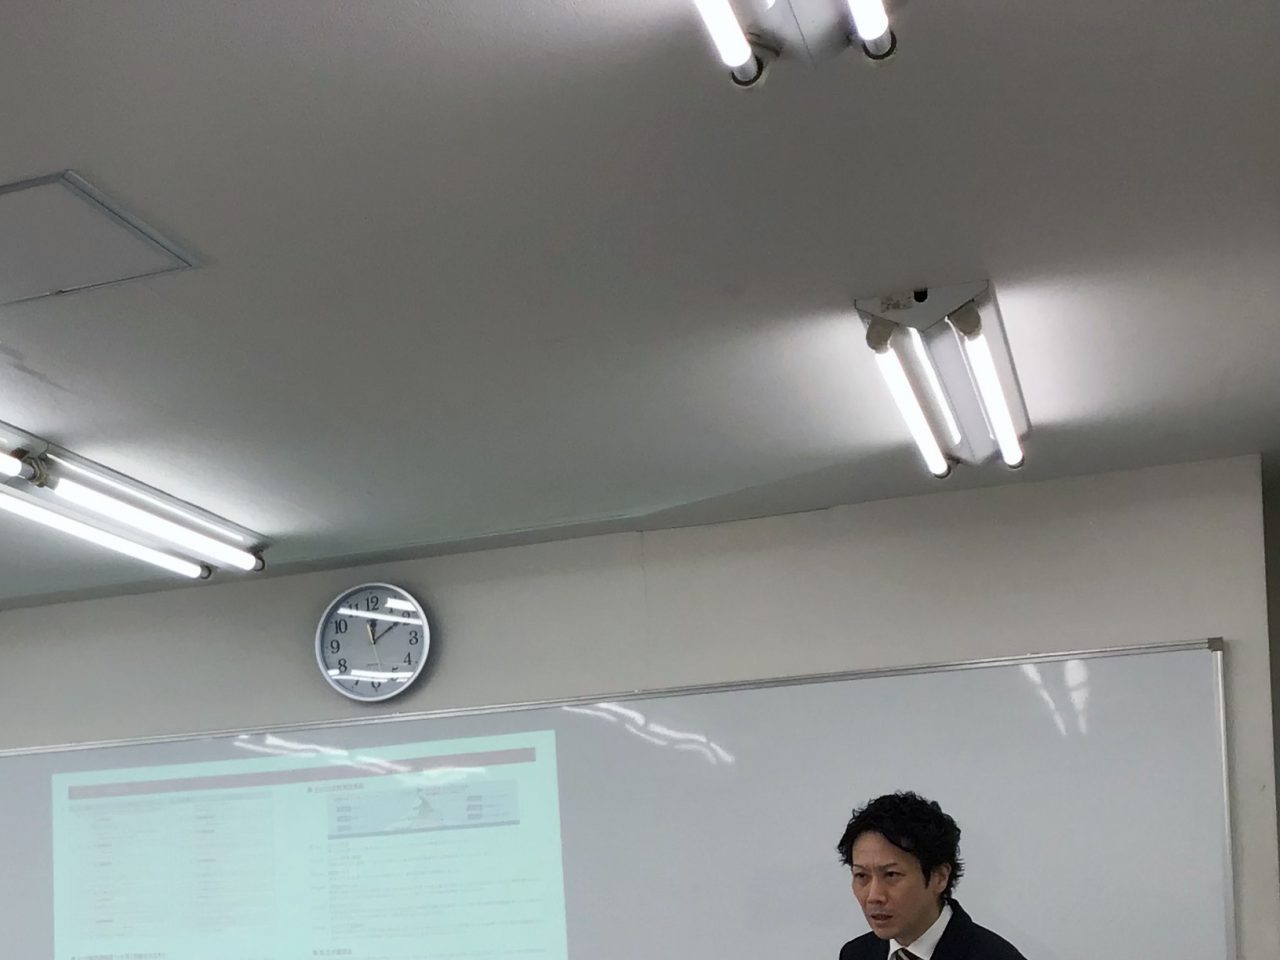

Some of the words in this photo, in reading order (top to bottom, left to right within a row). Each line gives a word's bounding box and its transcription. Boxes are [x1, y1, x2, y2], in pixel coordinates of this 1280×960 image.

[366, 596, 379, 611] 12
[334, 619, 348, 634] 10
[409, 631, 419, 645] 3
[330, 640, 340, 654] 9
[338, 658, 348, 673] 8
[403, 652, 412, 665] 4
